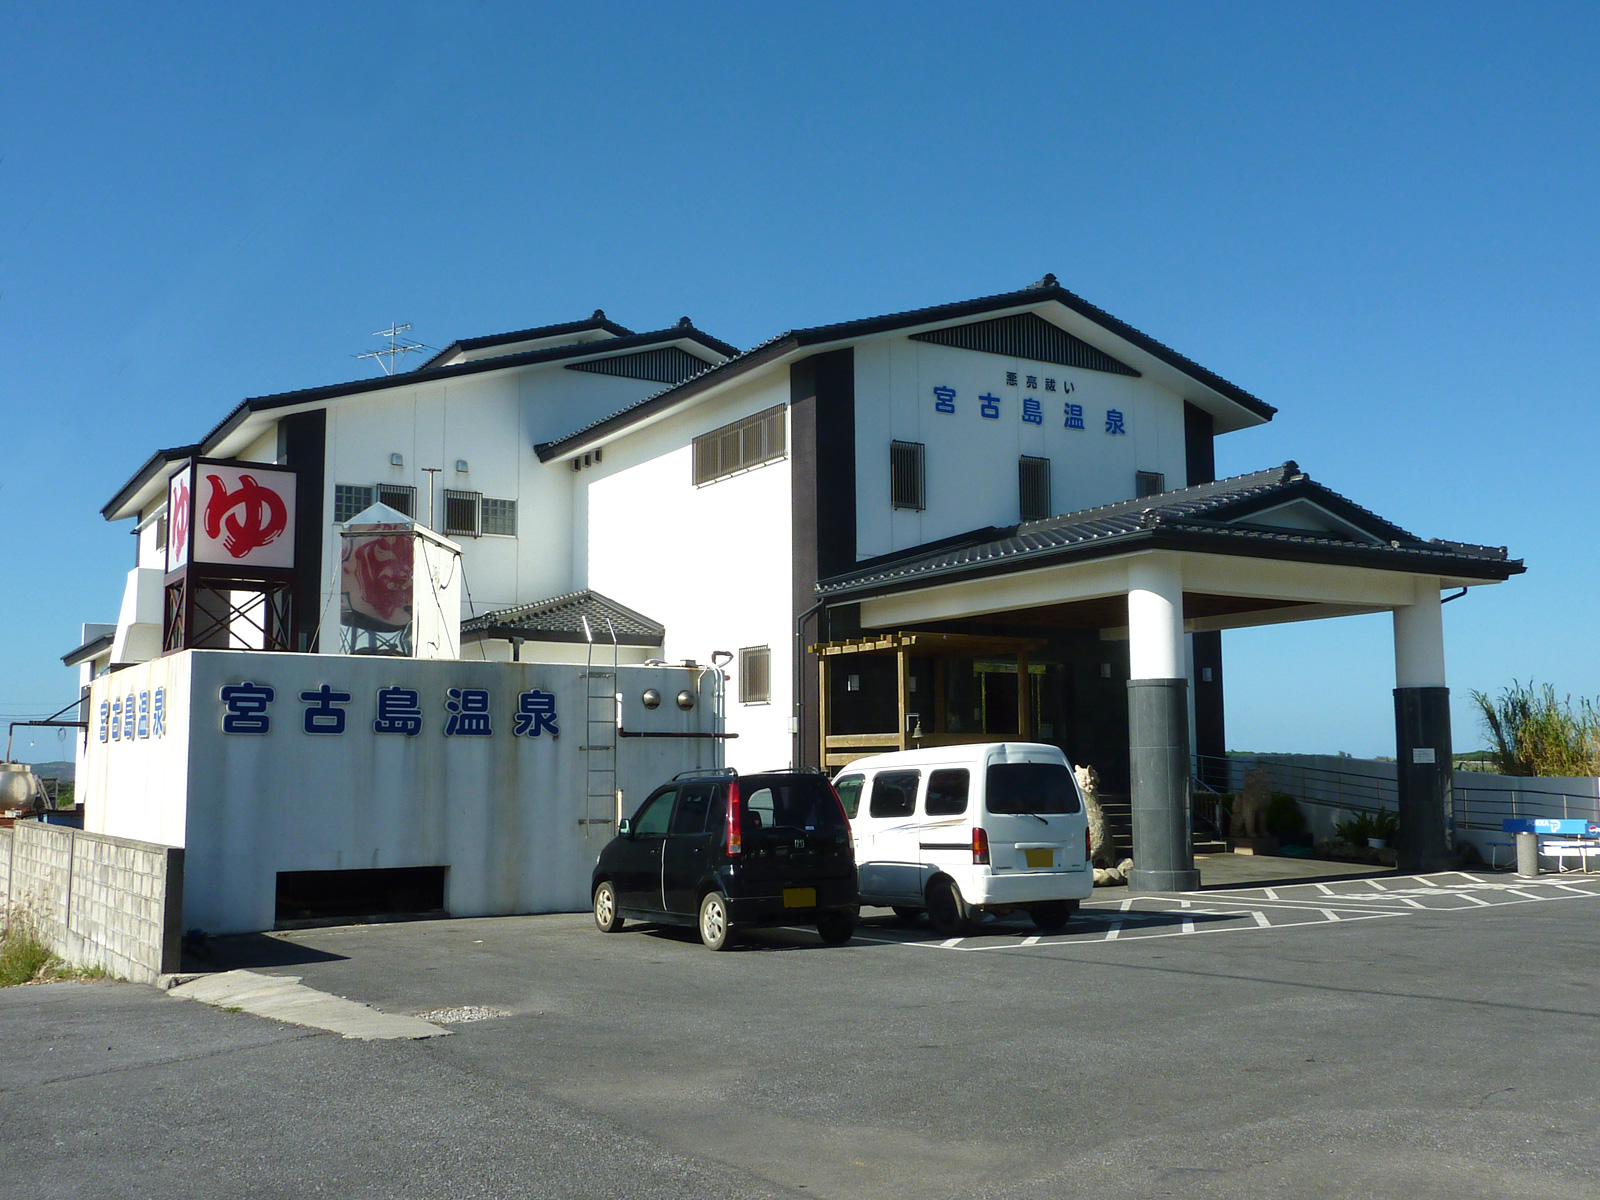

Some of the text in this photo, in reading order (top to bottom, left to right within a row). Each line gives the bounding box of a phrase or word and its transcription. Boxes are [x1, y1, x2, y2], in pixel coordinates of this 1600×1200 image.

[933, 385, 1126, 435] 宮古島温泉
[203, 474, 288, 559] ゆ
[99, 685, 165, 743] 宮古島温泉
[220, 681, 560, 738] 宮古島温泉
